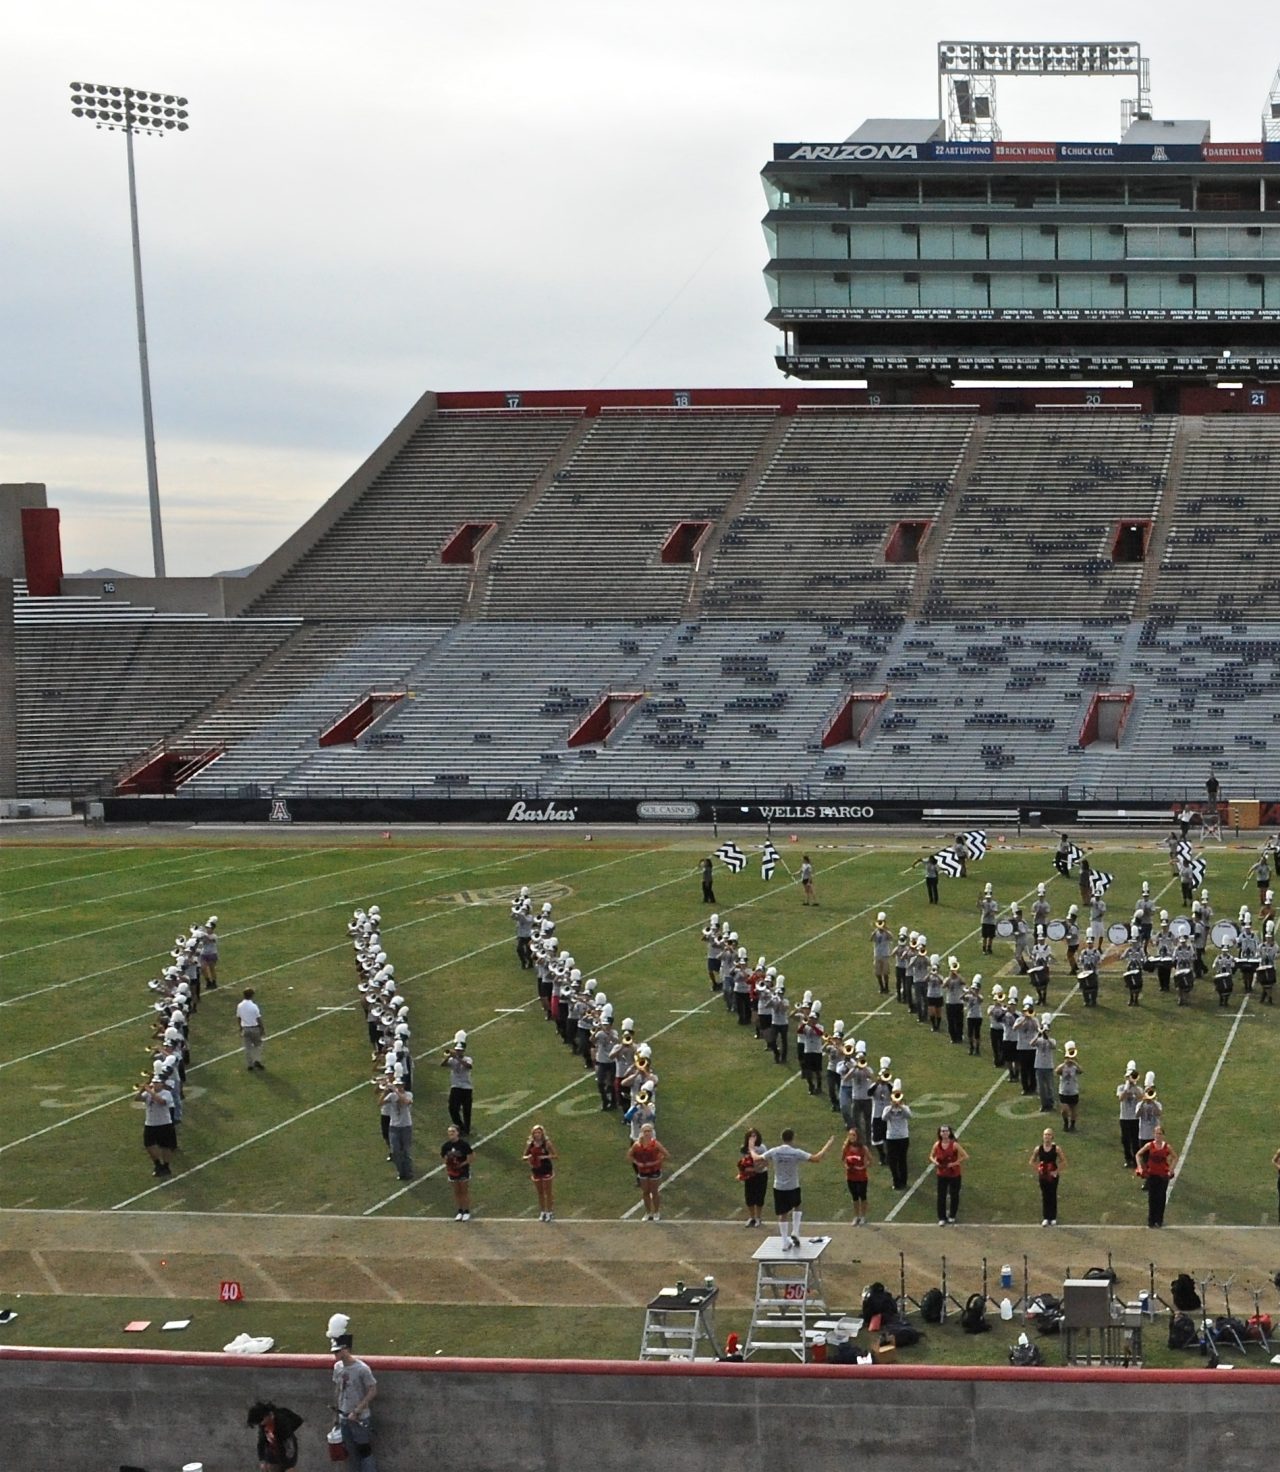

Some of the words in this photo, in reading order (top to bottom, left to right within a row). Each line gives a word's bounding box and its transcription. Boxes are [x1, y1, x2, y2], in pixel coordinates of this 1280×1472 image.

[789, 145, 918, 160] ARIZONA
[935, 146, 944, 154] 22
[1203, 148, 1207, 156] 4
[508, 399, 517, 408] 17
[676, 397, 688, 407] 18
[869, 396, 880, 405] 19
[1086, 395, 1100, 404] 20
[1252, 394, 1264, 404] 21
[104, 583, 115, 592] 16
[270, 800, 292, 821] A
[507, 802, 578, 821] Bashas'
[759, 806, 816, 818] WELLS
[819, 806, 874, 818] FARGO
[222, 1283, 239, 1300] 40
[786, 1284, 803, 1299] 50
